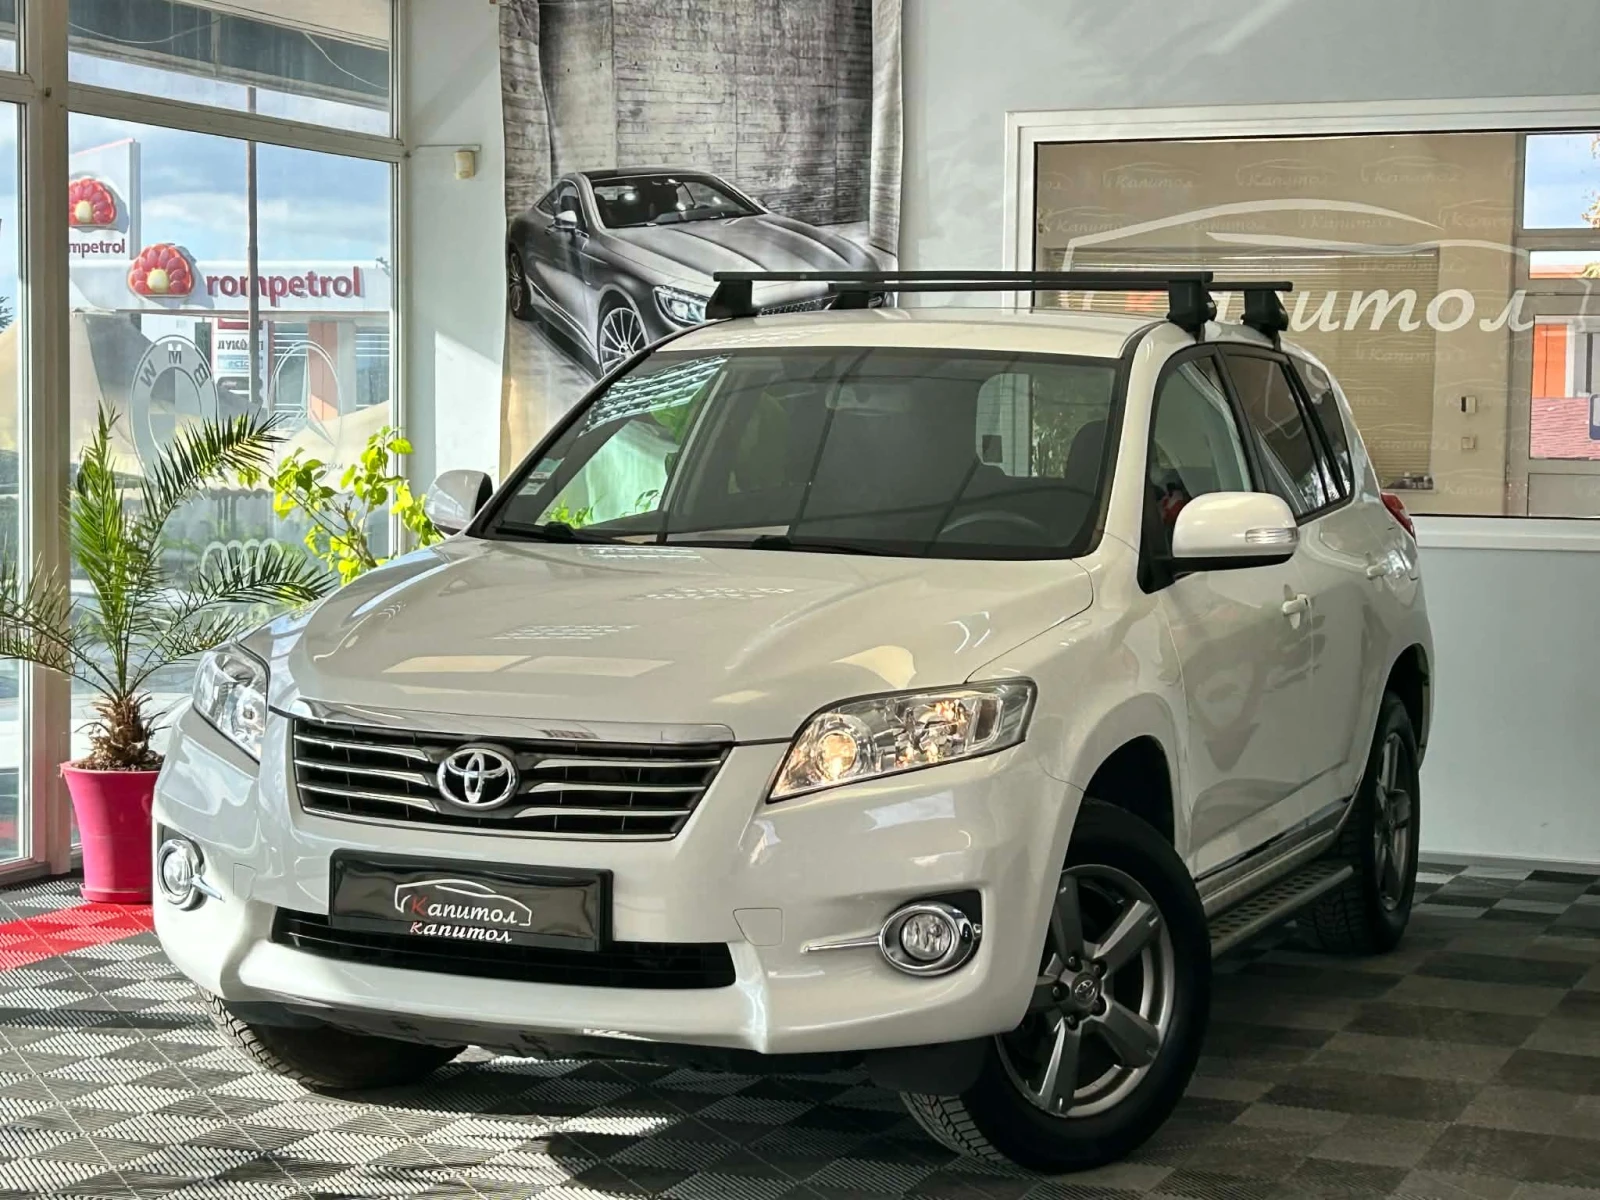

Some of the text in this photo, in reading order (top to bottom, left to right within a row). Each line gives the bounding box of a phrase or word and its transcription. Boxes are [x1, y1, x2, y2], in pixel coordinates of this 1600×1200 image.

[69, 238, 126, 258] mpetrol
[206, 265, 361, 308] rompetrol
[411, 896, 517, 924] Капитол
